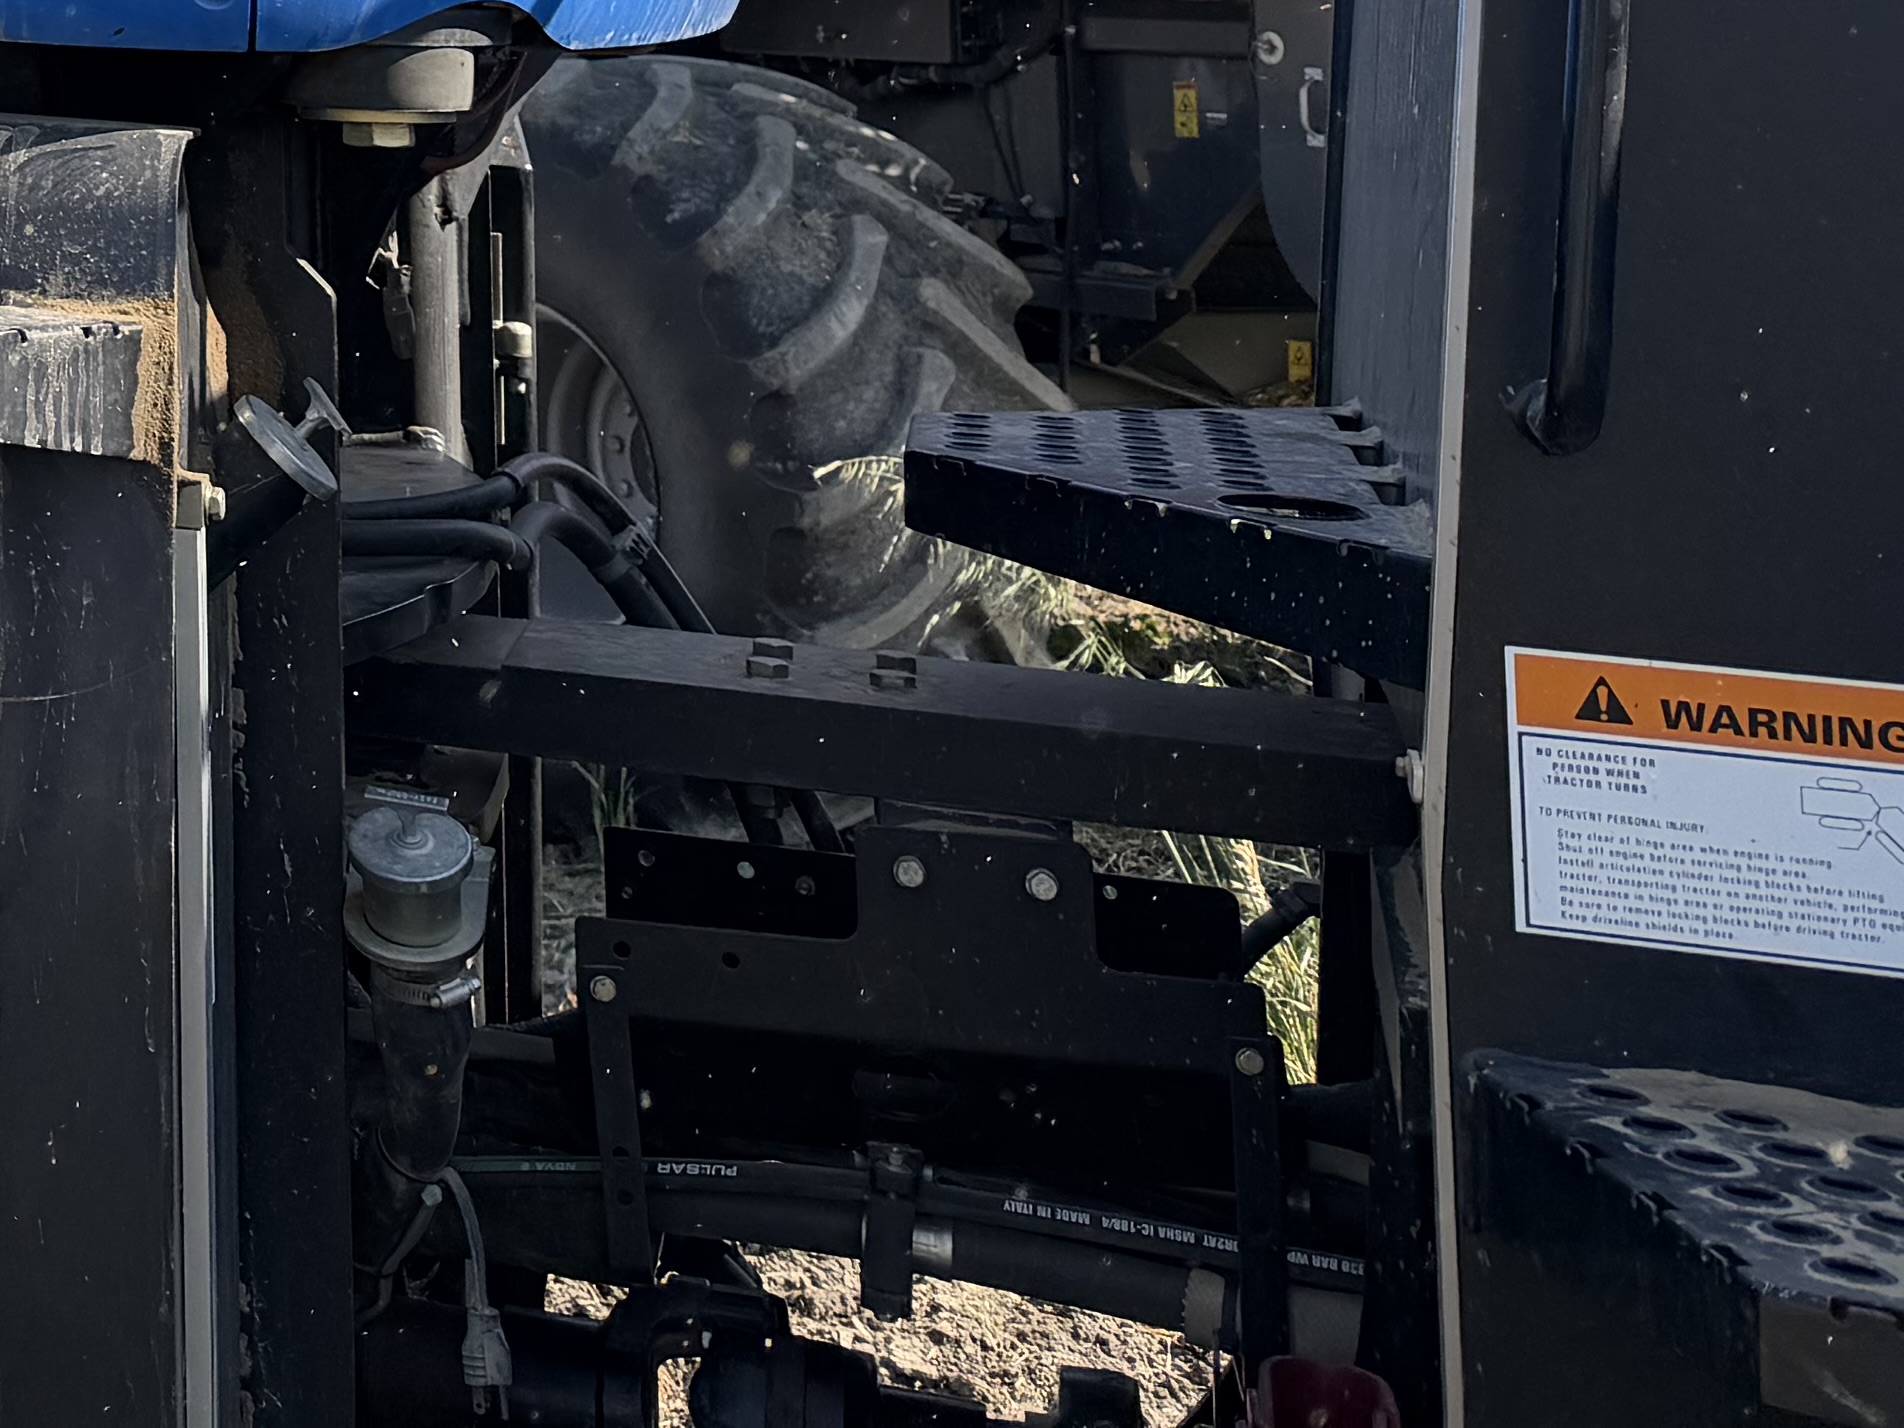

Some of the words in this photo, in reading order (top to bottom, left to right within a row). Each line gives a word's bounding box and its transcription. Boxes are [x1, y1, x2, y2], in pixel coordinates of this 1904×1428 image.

[1660, 698, 1904, 754] WARNING
[1536, 747, 1552, 757] NO
[1557, 748, 1627, 765] CLEARANCE
[1633, 756, 1656, 768] FOR
[1552, 762, 1600, 775] PERSON
[1605, 767, 1641, 780] WHEN
[1546, 774, 1602, 790] TRACTOR
[1607, 782, 1647, 794] TURNS
[1539, 806, 1552, 817] TO
[1556, 808, 1602, 822] PREVENT
[1607, 814, 1661, 829] PERSONAL
[1557, 828, 1582, 841] Stay
[1587, 832, 1614, 844] clear
[1619, 836, 1630, 846] of
[1635, 837, 1665, 850] hinge
[1670, 843, 1694, 853] area
[1699, 846, 1729, 857] when
[1733, 850, 1770, 862] engine
[1775, 853, 1784, 863] is
[1558, 842, 1583, 854] Shut
[1588, 846, 1604, 856] off
[1609, 849, 1645, 861] engine
[1649, 853, 1686, 865] before
[1690, 858, 1742, 873] servicing
[1746, 864, 1777, 877] hinge
[1558, 855, 1594, 868] Install
[1598, 861, 1665, 876] articulation
[1669, 869, 1714, 882] cylinder
[1719, 874, 1761, 889] locking
[1764, 879, 1802, 892] blocks
[1806, 884, 1843, 897] before
[1848, 889, 1885, 904] lifting
[1559, 884, 1629, 900] maintenance
[1634, 893, 1645, 901] in
[1649, 894, 1679, 907] hinge
[1683, 899, 1708, 909] area
[1712, 902, 1724, 911] or
[1729, 904, 1783, 920] operating
[1788, 911, 1848, 927] stationary
[1853, 916, 1877, 929] PTO
[1606, 875, 1677, 893] transporting
[1681, 884, 1721, 897] tractor
[1726, 890, 1740, 899] on
[1745, 892, 1788, 904] another
[1842, 904, 1904, 920] performing
[1560, 896, 1574, 907] Be
[1578, 899, 1602, 910] sure
[1606, 902, 1618, 912] to
[1623, 905, 1662, 917] remove
[1667, 909, 1708, 924] locking
[1712, 915, 1750, 928] blocks
[1753, 919, 1791, 933] before
[1796, 924, 1835, 940] driving
[1560, 910, 1588, 923] Keep
[1592, 913, 1641, 929] driveline
[1645, 921, 1684, 934] shields
[1689, 927, 1699, 935] in
[656, 1162, 737, 1177] PULSAR
[1003, 1199, 1033, 1215] ITALY
[1036, 1205, 1052, 1219] IN
[1055, 1207, 1090, 1225] MADE
[1157, 1225, 1195, 1244] MSHA
[1286, 1251, 1309, 1266] WP
[1312, 1255, 1338, 1271] BAR
